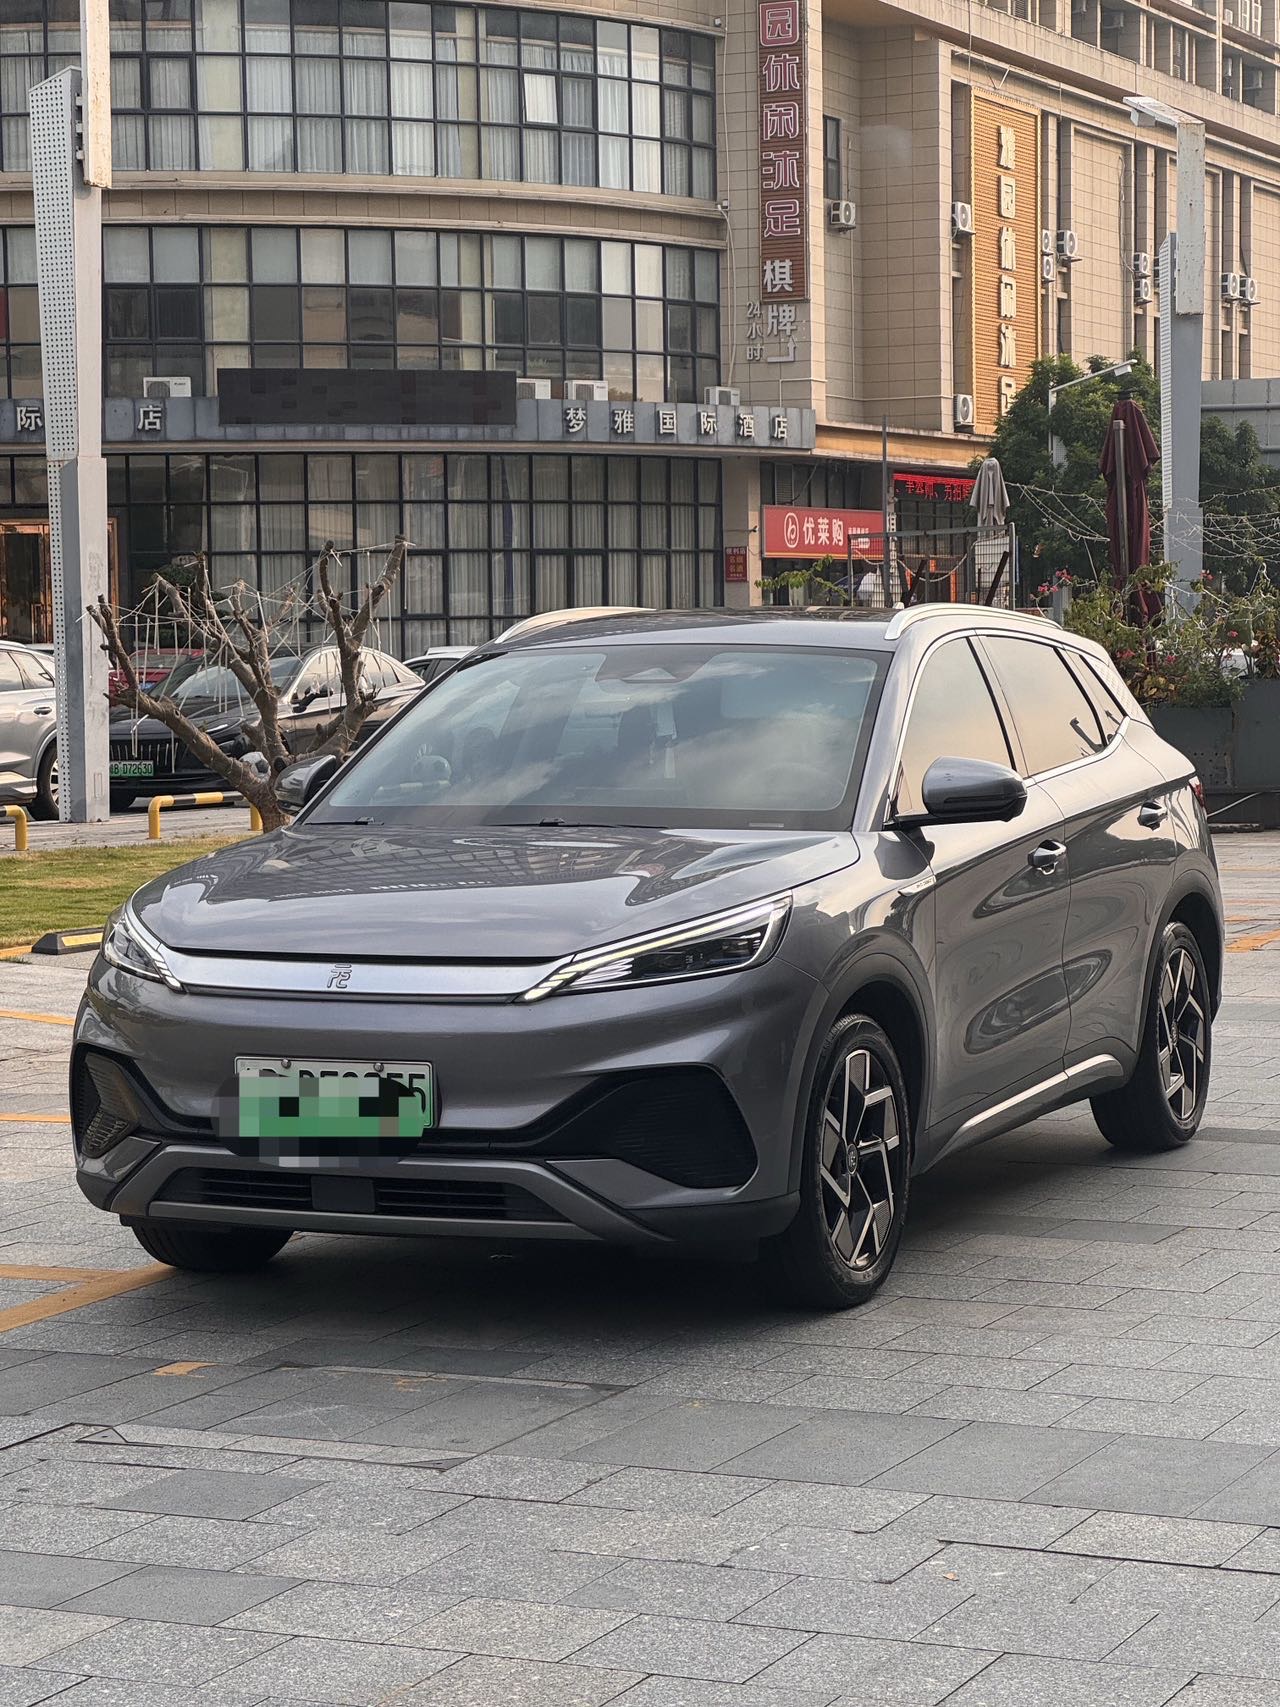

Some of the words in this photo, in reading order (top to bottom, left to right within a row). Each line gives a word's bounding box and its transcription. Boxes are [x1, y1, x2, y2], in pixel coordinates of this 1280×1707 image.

[763, 258, 797, 336] 棋牌
[566, 407, 788, 438] 梦雅国际酒店
[803, 517, 843, 546] 优莱购
